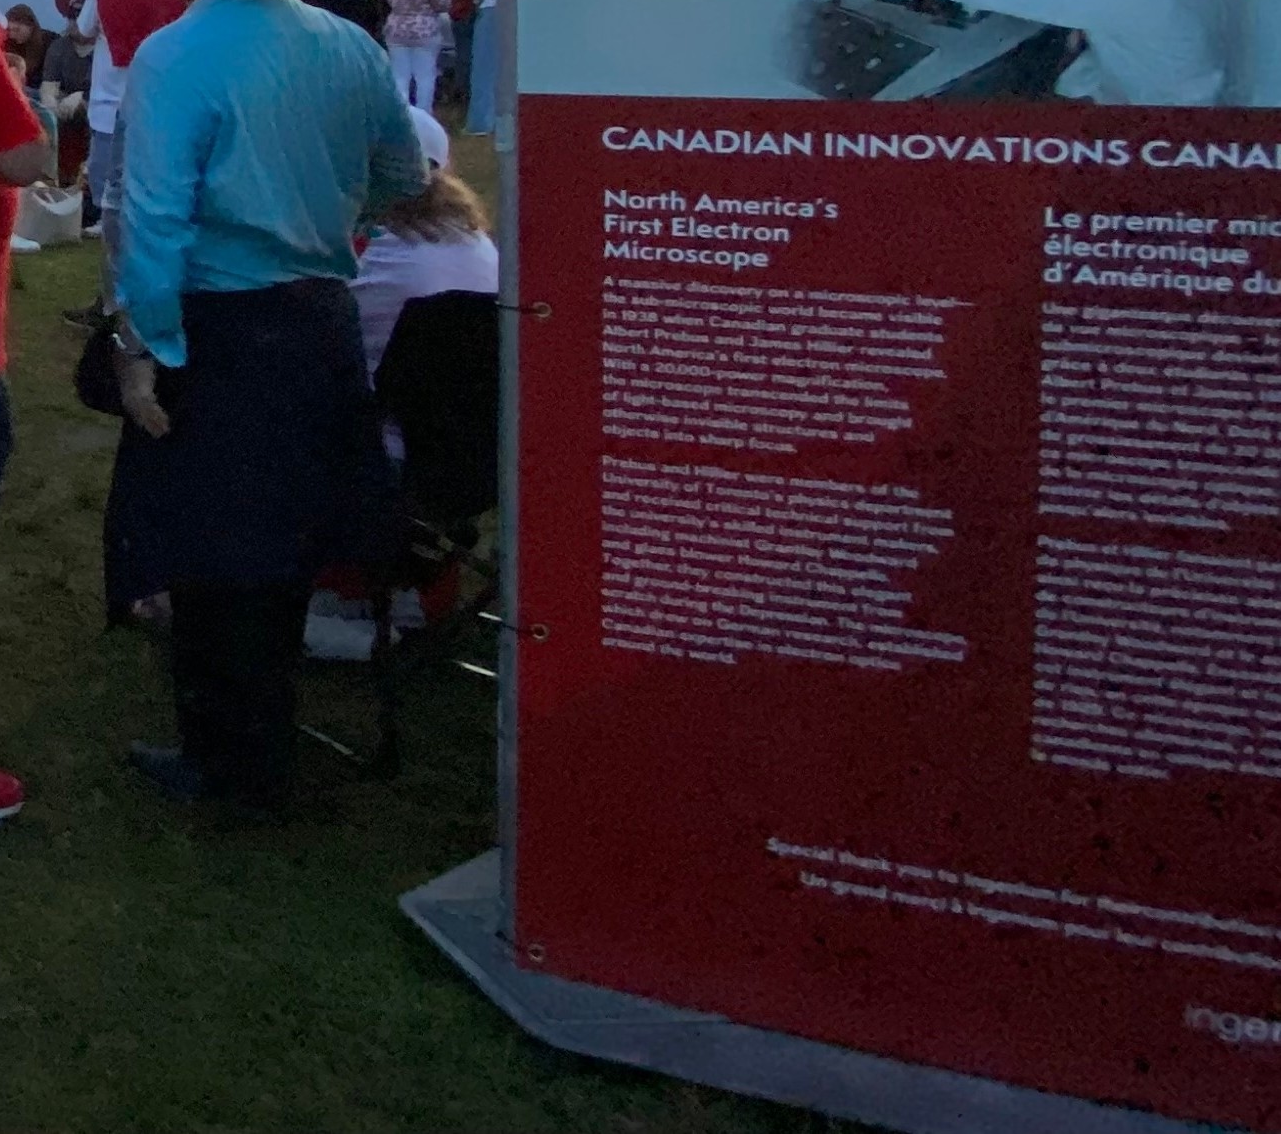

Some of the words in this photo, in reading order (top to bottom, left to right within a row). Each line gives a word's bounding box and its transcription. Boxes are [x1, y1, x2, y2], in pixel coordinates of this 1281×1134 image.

[601, 126, 812, 156] CANADIAN
[824, 132, 1131, 167] INNOVATIONS
[1140, 140, 1281, 170] CANA
[604, 189, 687, 213] North
[692, 193, 839, 219] America's
[604, 213, 663, 236] First
[671, 214, 791, 242] Electron
[1044, 206, 1083, 230] Le
[1090, 210, 1219, 236] premier
[1227, 215, 1281, 237] mic
[603, 239, 771, 270] Microscope
[1043, 233, 1251, 269] électronique
[1043, 261, 1235, 297] d'Amérique
[1242, 270, 1281, 295] du
